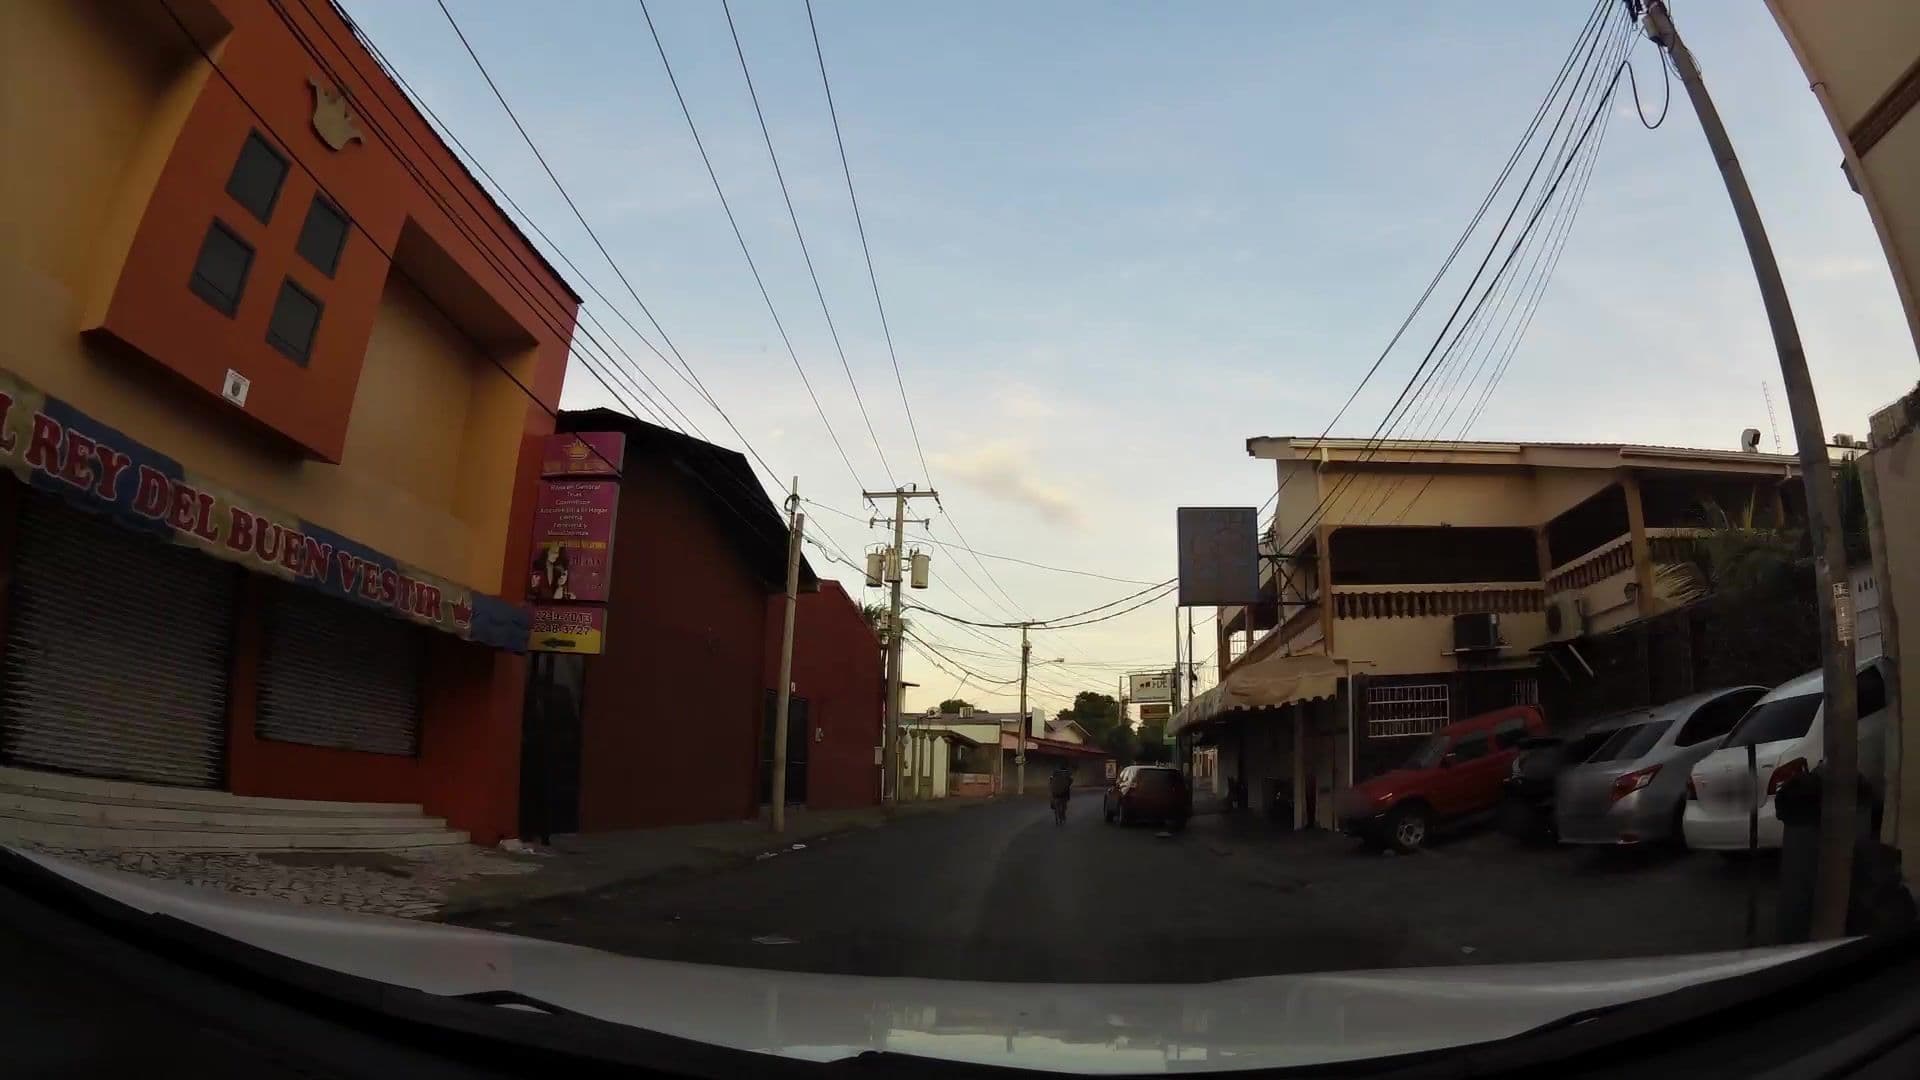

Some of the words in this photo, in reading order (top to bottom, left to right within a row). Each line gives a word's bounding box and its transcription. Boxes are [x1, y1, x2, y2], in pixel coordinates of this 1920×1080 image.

[24, 411, 131, 501] REY
[132, 464, 219, 544] DEL
[226, 505, 333, 584] BUEN
[337, 551, 443, 623] VESTIR
